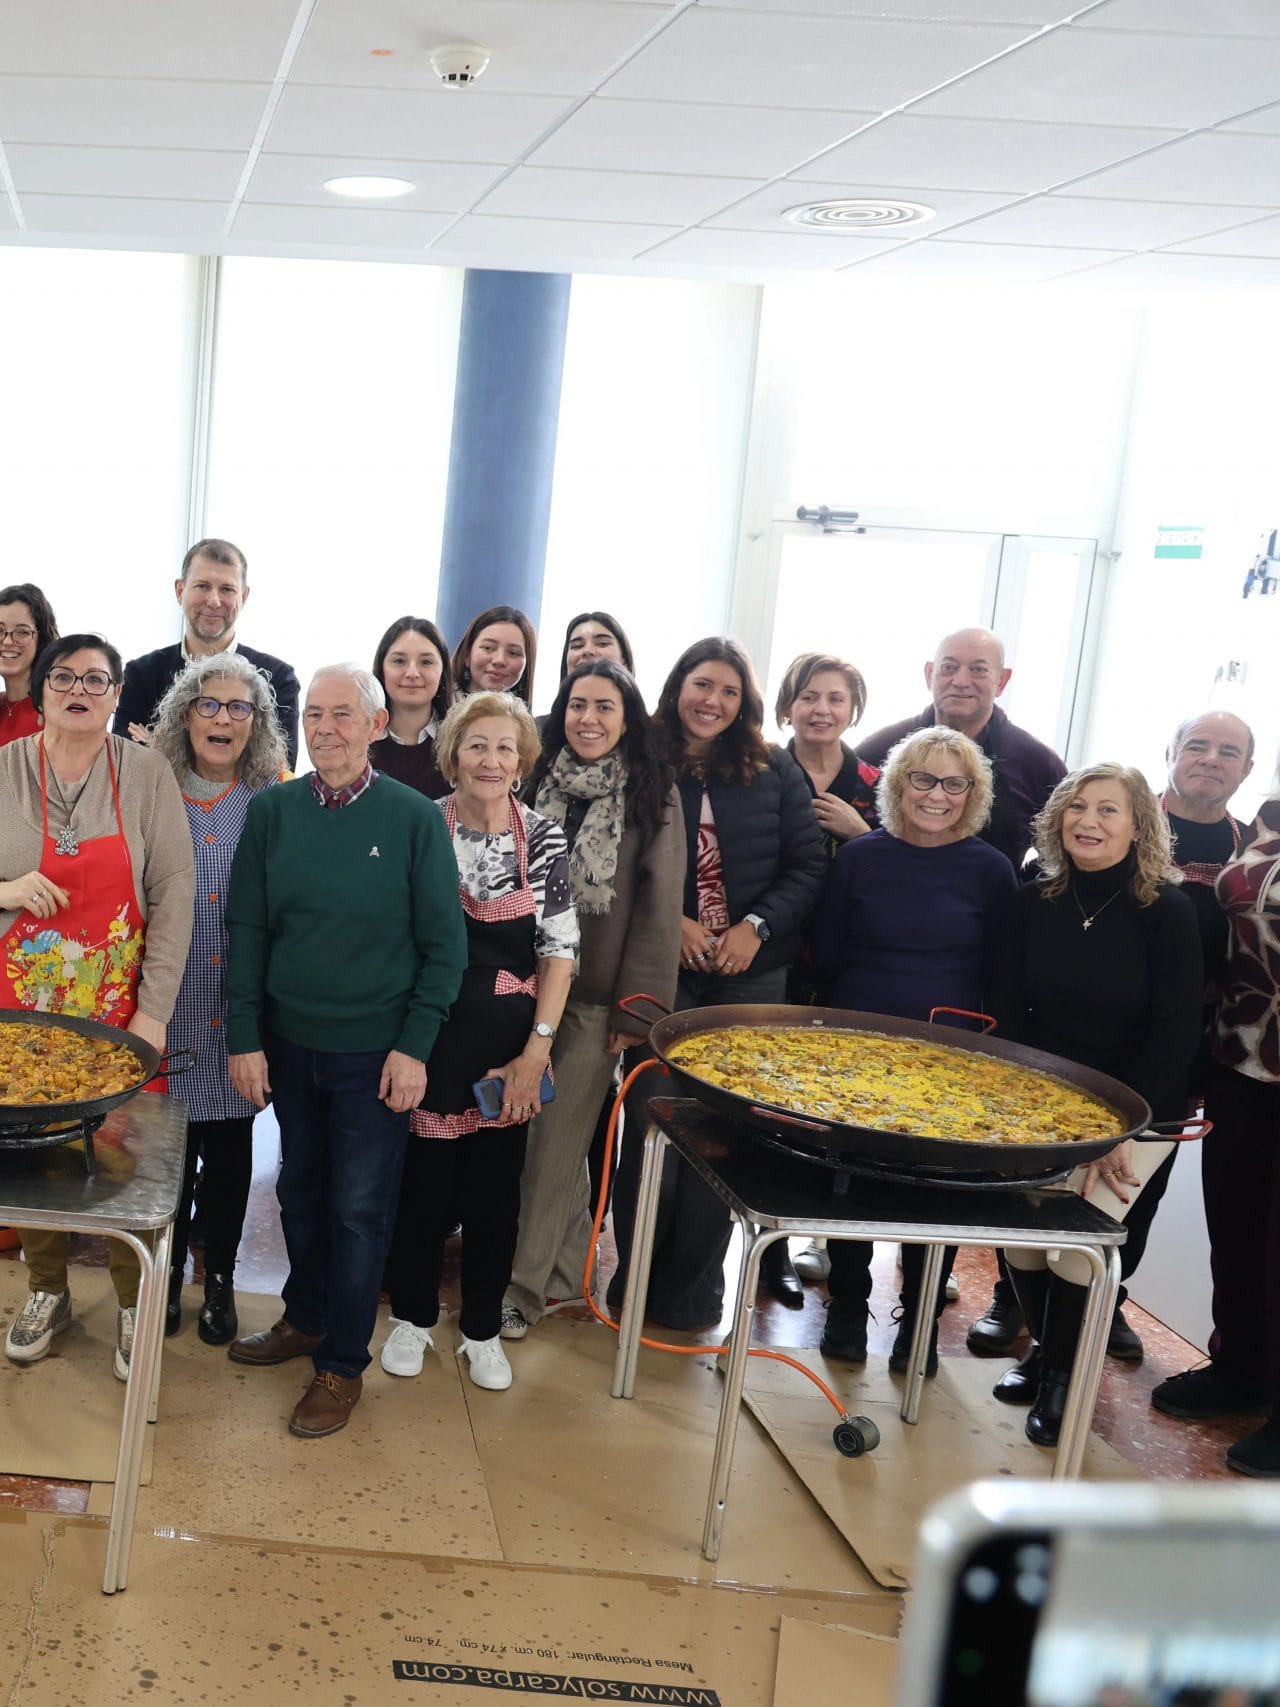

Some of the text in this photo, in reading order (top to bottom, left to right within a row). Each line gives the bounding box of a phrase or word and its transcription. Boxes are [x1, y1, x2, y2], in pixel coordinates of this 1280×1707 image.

[404, 1635, 423, 1643] cm
[427, 1637, 443, 1647] 74
[482, 1643, 498, 1653] 74
[537, 1649, 559, 1659] 180
[655, 1659, 695, 1673] Mesa
[402, 1663, 714, 1706] wwwsolycarpa.com
